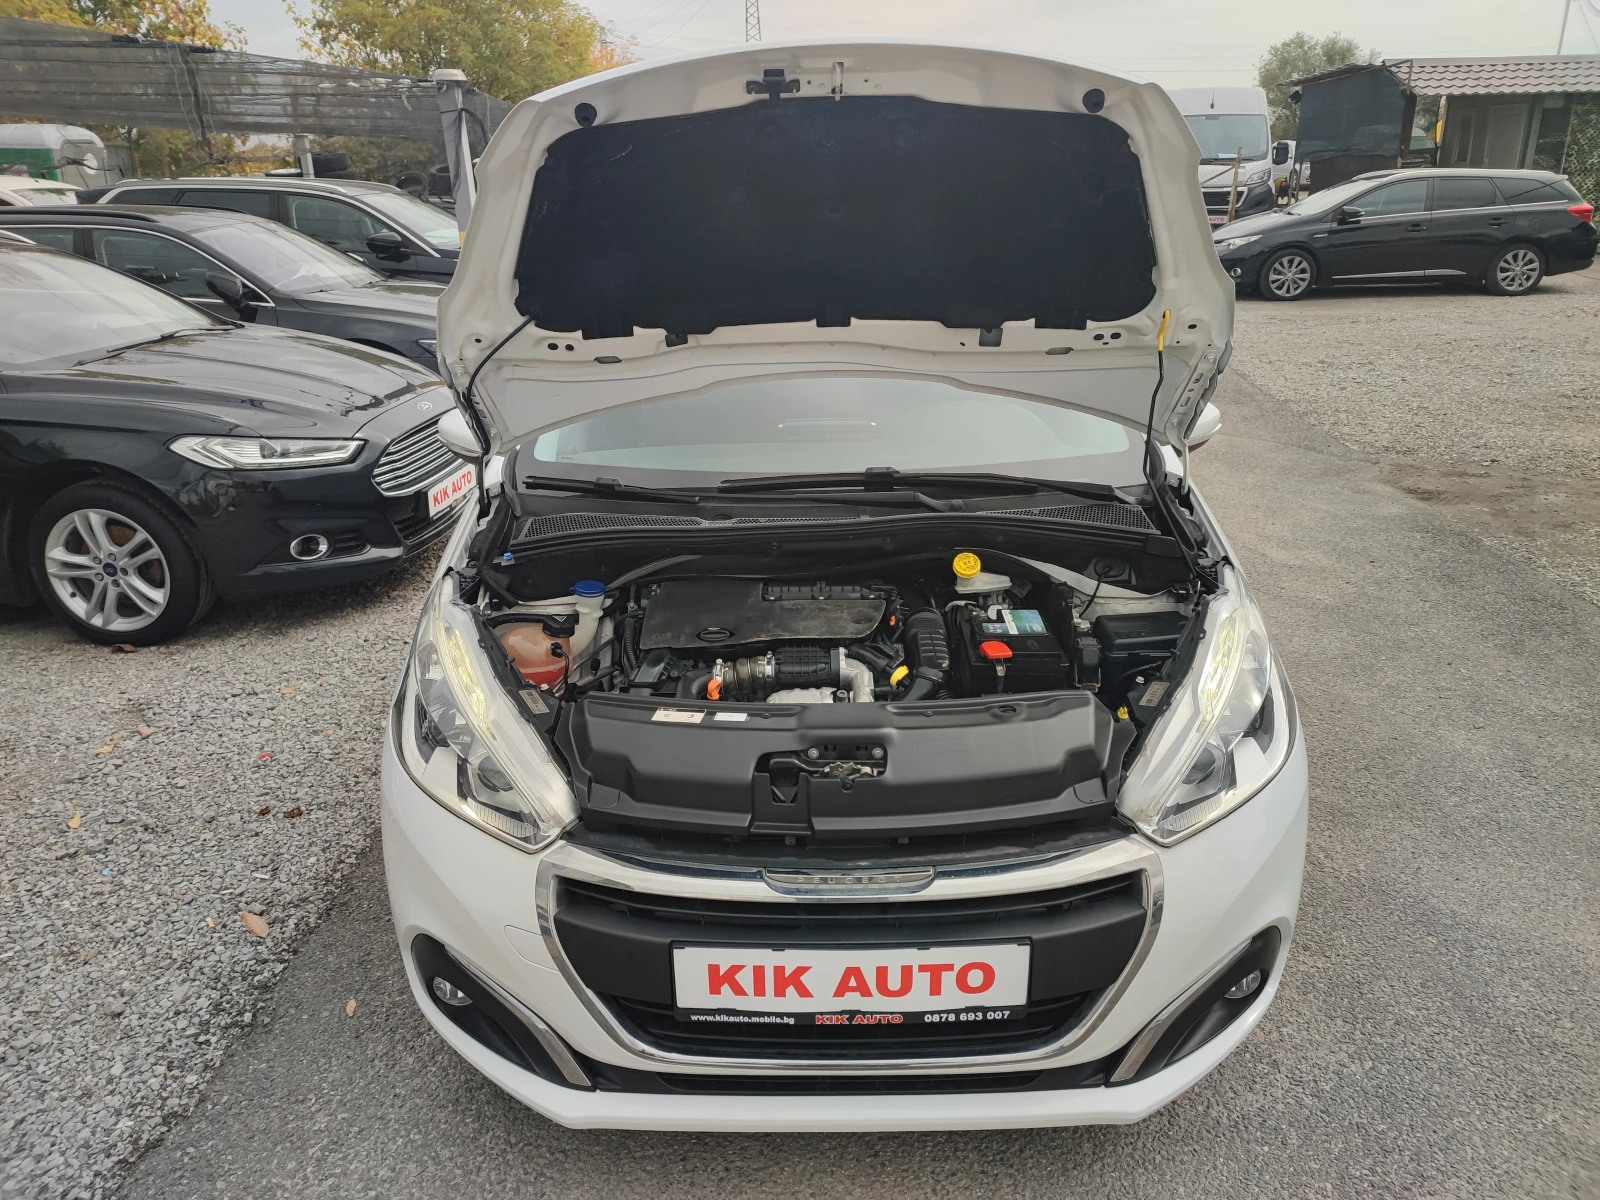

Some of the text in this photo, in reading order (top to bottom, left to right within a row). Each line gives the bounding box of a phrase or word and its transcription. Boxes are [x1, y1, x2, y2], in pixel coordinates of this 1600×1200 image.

[432, 485, 450, 507] KIK
[452, 470, 472, 495] AUTO
[707, 961, 996, 998] KIK AUTO
[690, 1014, 795, 1025] www.kikauto.mobile.bg
[815, 1014, 904, 1025] KIK AUTO
[924, 1010, 1011, 1023] 0878 693 007
